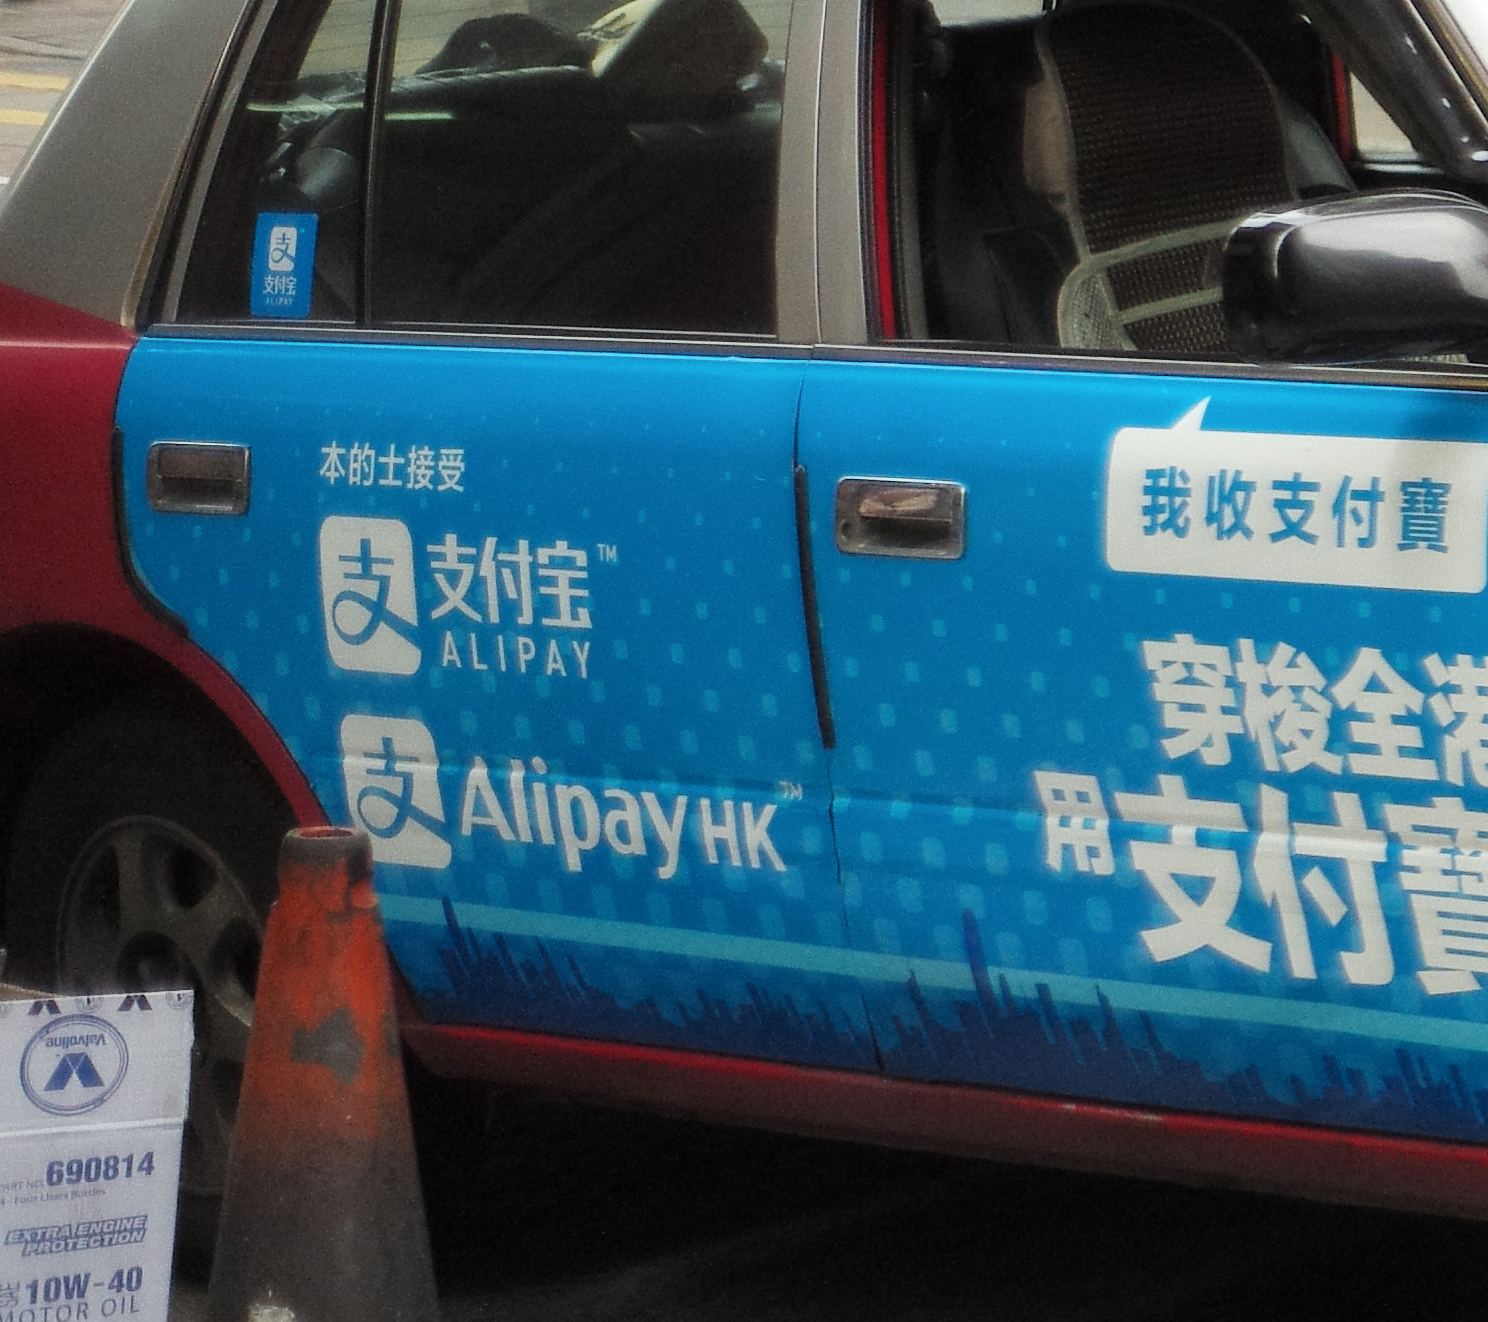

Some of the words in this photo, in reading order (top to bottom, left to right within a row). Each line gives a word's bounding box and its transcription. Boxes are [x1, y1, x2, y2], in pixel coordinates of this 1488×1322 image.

[263, 274, 298, 296] 支付宝
[318, 440, 467, 493] 本的士接受
[1140, 465, 1453, 556] 我收支付寶
[425, 533, 593, 629] 支付宝
[441, 630, 592, 680] ALIPAY
[45, 1033, 108, 1050] Valvoline
[45, 1150, 155, 1187] 690814
[5, 1223, 74, 1246] EXTRA
[74, 1215, 149, 1238] ENGINE
[21, 1229, 148, 1257] PROTECTION
[100, 1294, 141, 1319] OIL
